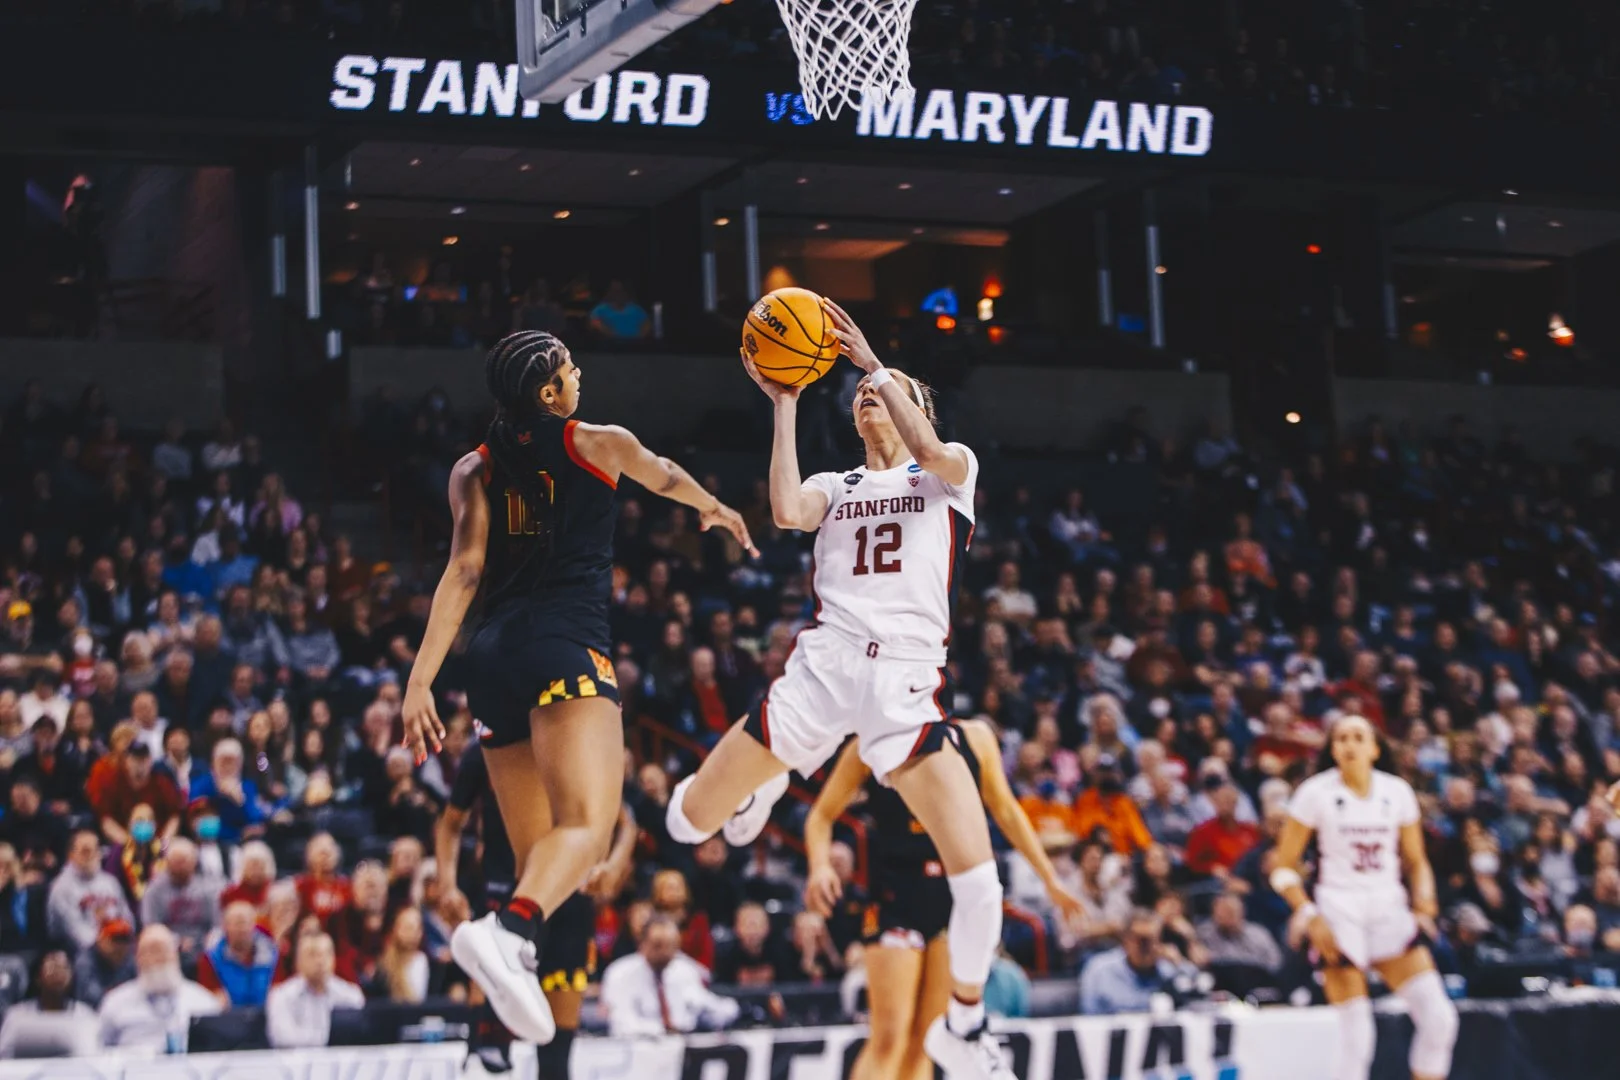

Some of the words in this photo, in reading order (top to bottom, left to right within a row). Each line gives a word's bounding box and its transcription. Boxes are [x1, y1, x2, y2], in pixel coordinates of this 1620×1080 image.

[329, 54, 711, 127] STANORD
[856, 88, 1213, 156] MARYLAND
[835, 496, 925, 521] STANFORD
[853, 522, 902, 576] 12
